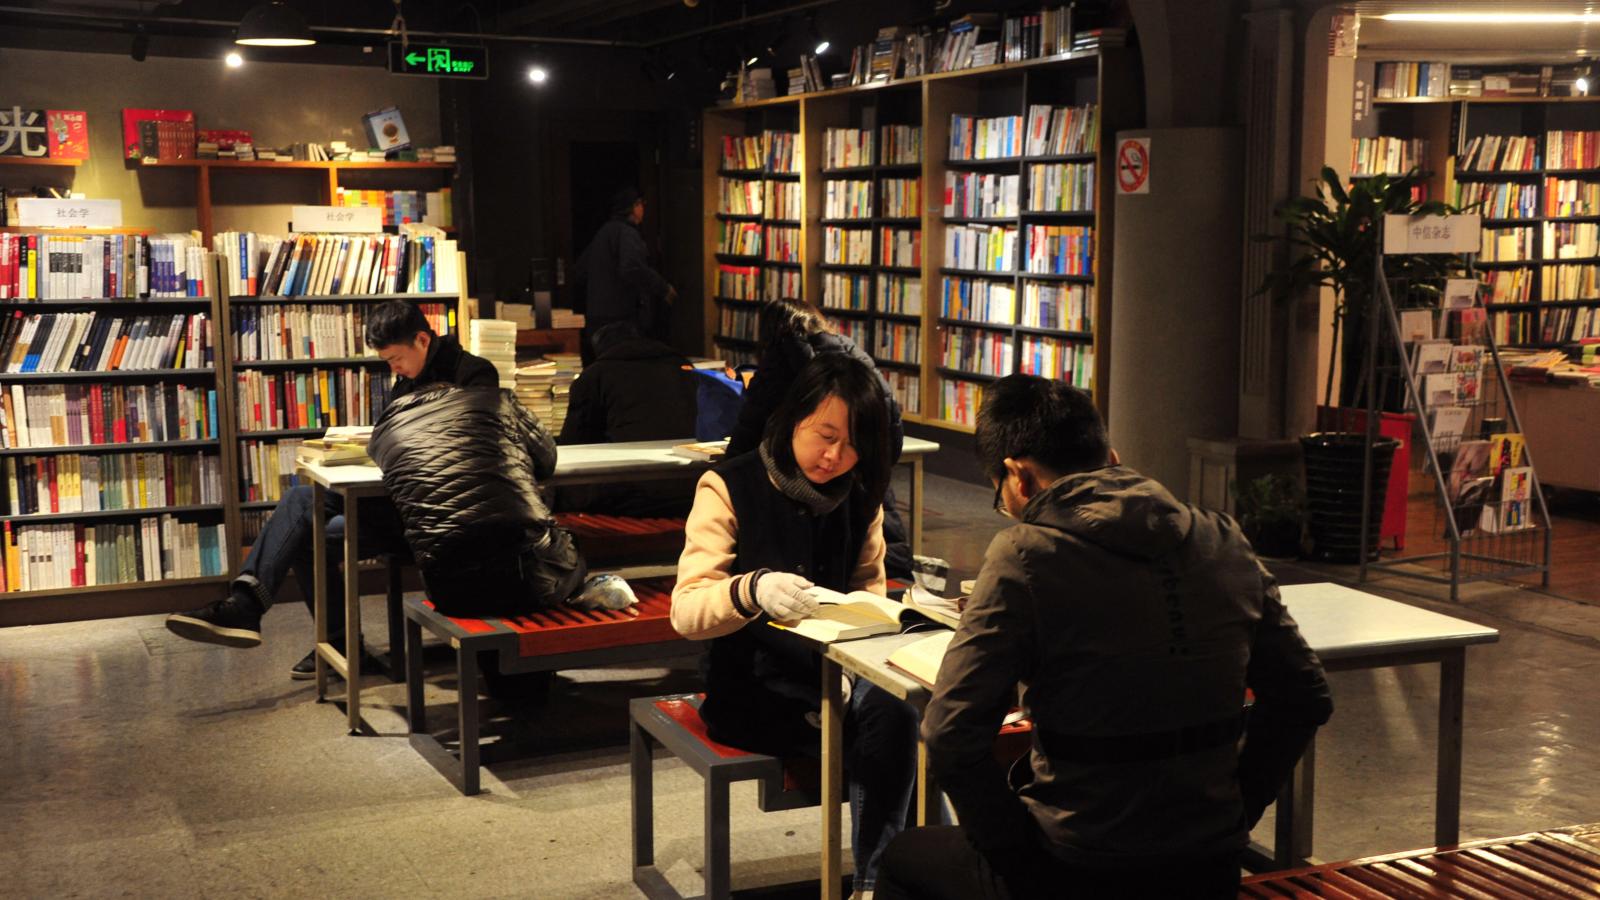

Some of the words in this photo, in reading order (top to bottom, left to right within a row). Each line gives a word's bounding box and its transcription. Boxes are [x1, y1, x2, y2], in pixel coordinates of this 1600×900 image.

[0, 106, 47, 156] 光
[56, 207, 89, 218] 社会学
[326, 211, 355, 222] 社会学
[1412, 225, 1450, 240] 中信杂志
